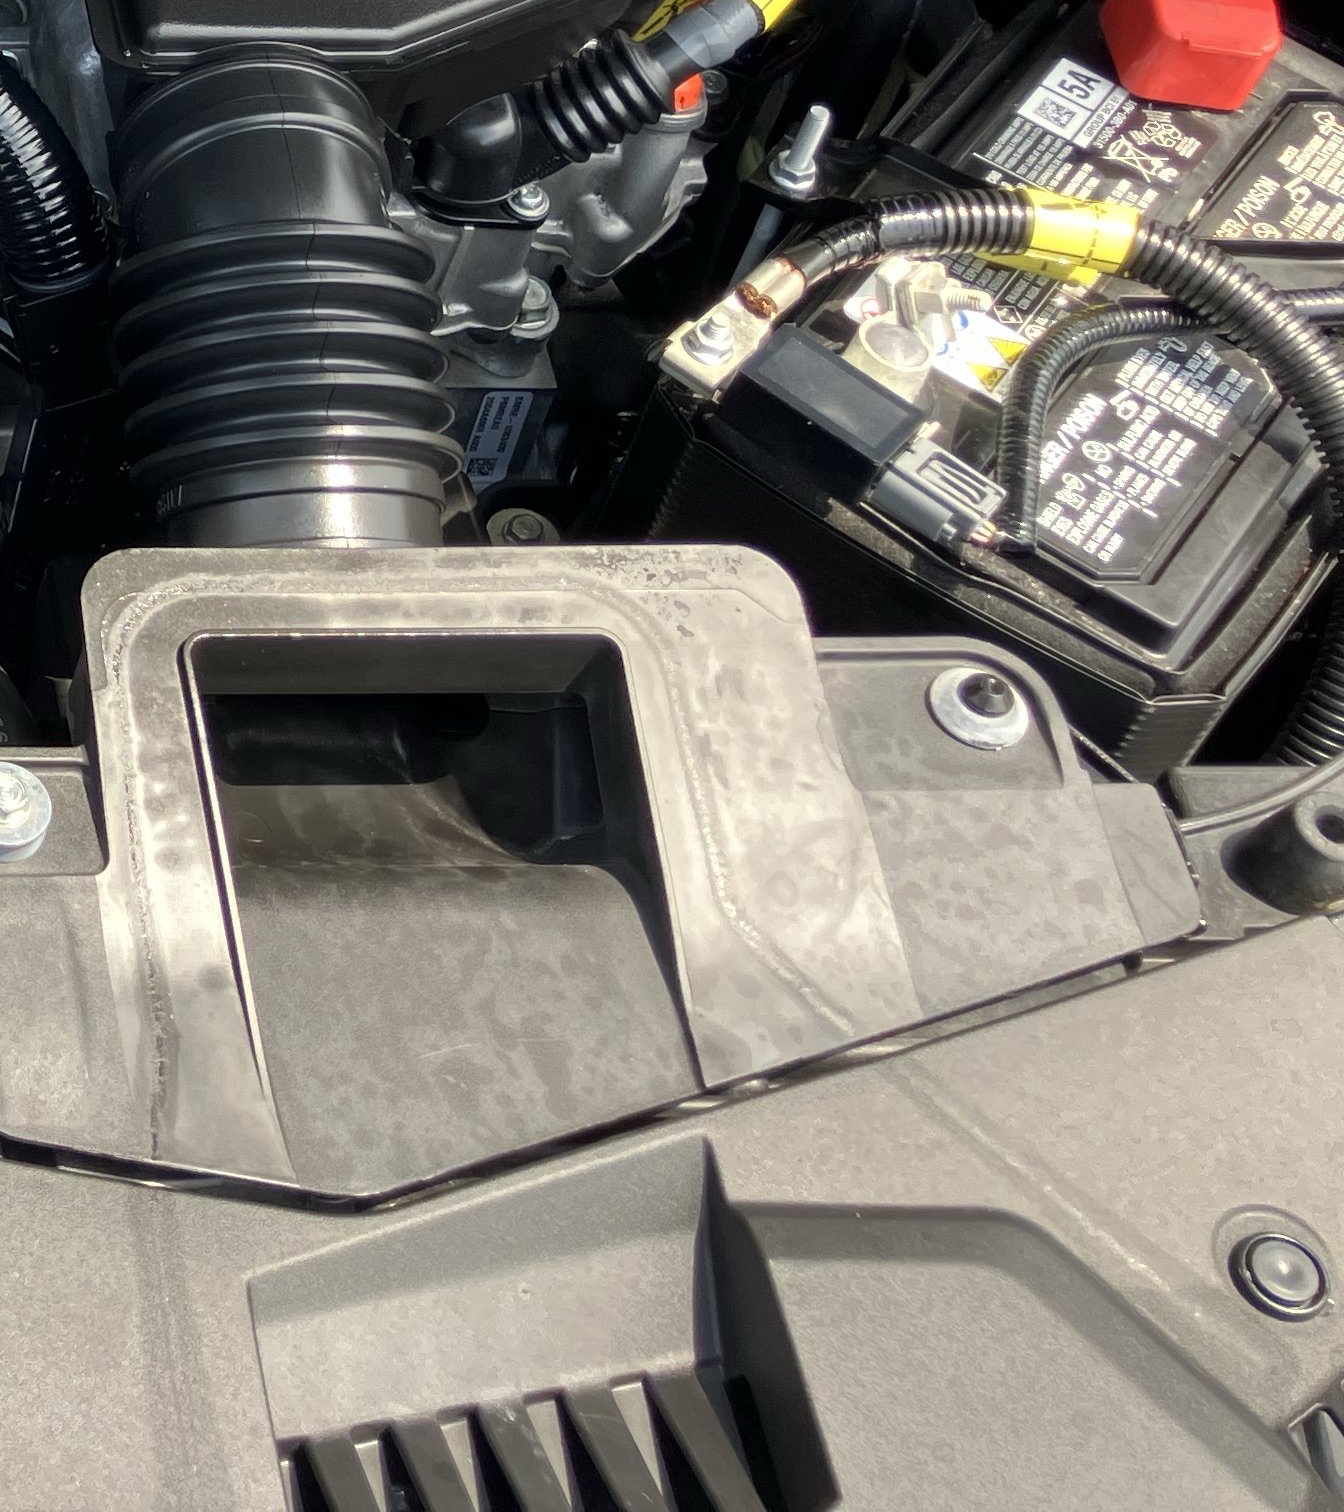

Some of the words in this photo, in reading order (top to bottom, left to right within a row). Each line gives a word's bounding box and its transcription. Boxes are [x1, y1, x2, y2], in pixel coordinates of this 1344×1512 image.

[1061, 69, 1102, 100] 5A
[1083, 112, 1107, 138] GROUP
[1212, 218, 1247, 238] GER
[1236, 175, 1281, 218] POISON
[1061, 392, 1109, 440] POISON
